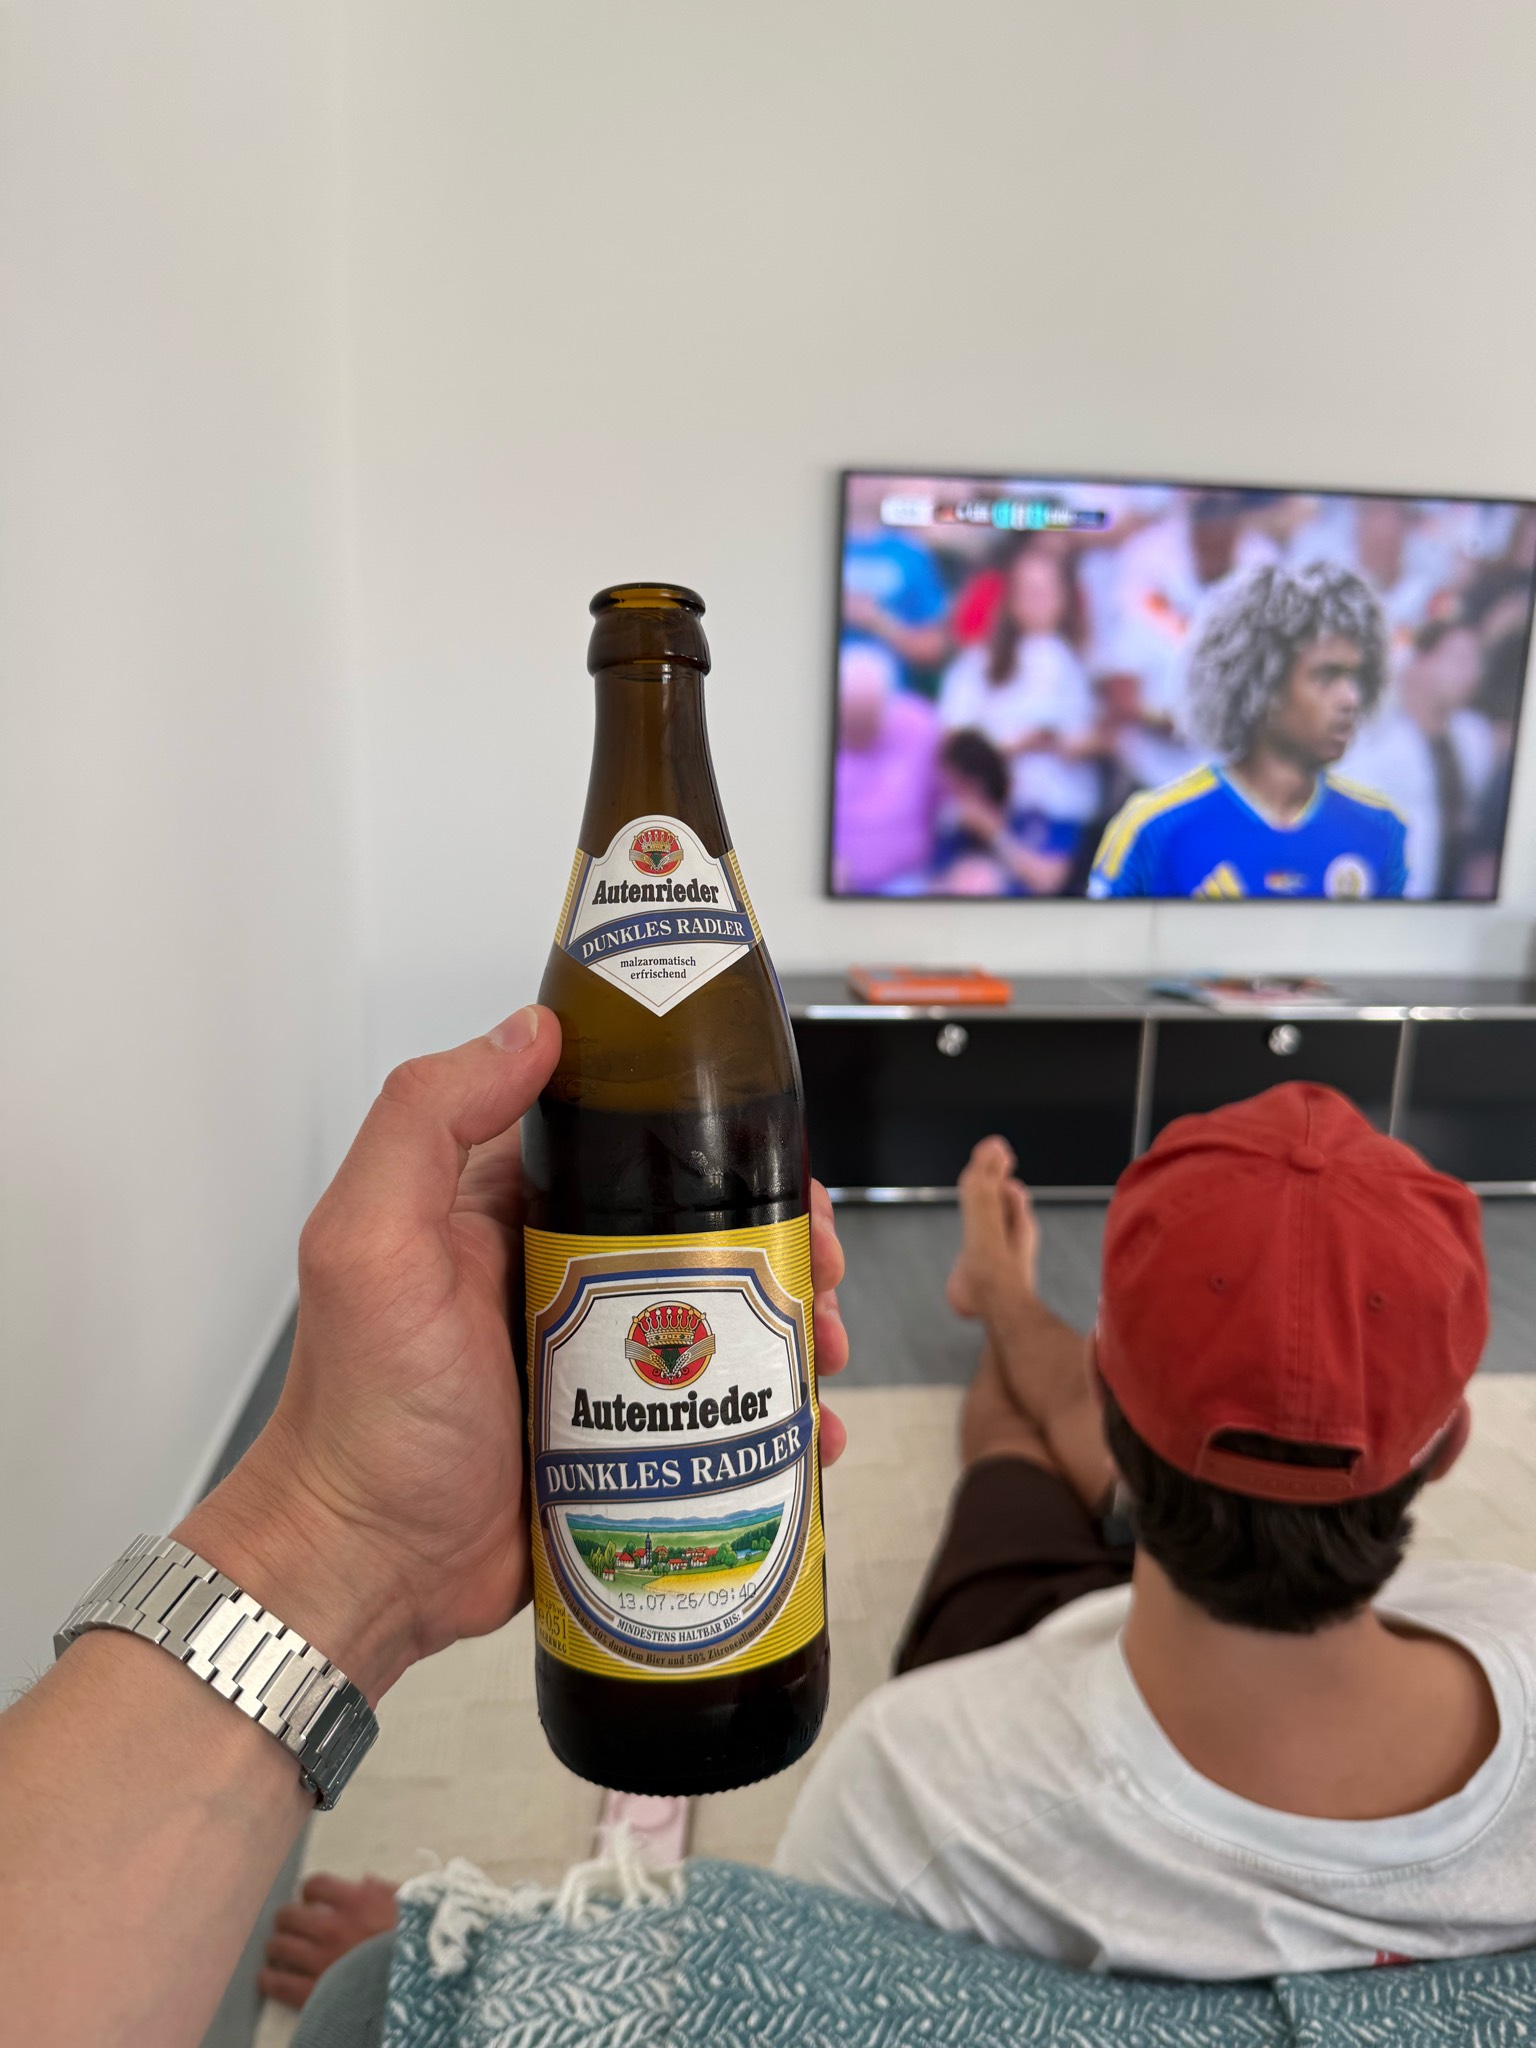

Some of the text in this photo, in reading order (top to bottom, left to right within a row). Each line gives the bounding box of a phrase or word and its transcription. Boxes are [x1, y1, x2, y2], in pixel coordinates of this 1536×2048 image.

[592, 878, 719, 905] Autenrieder
[582, 918, 746, 959] DUNKLES RADLER
[620, 956, 697, 968] malzaromatisch
[630, 968, 687, 980] erfrischend
[571, 1385, 772, 1432] Autenrieder
[546, 1425, 802, 1494] DUNKLES RADLER
[592, 1627, 607, 1645] 50%
[608, 1636, 643, 1661] dunklem
[646, 1655, 666, 1665] Bier
[668, 1654, 685, 1666] und
[687, 1653, 706, 1664] 50%
[708, 1610, 773, 1659] Zitronenlimonade
[773, 1596, 784, 1610] mit
[617, 1613, 742, 1642] MINDESTENS HALTBAR BIS:
